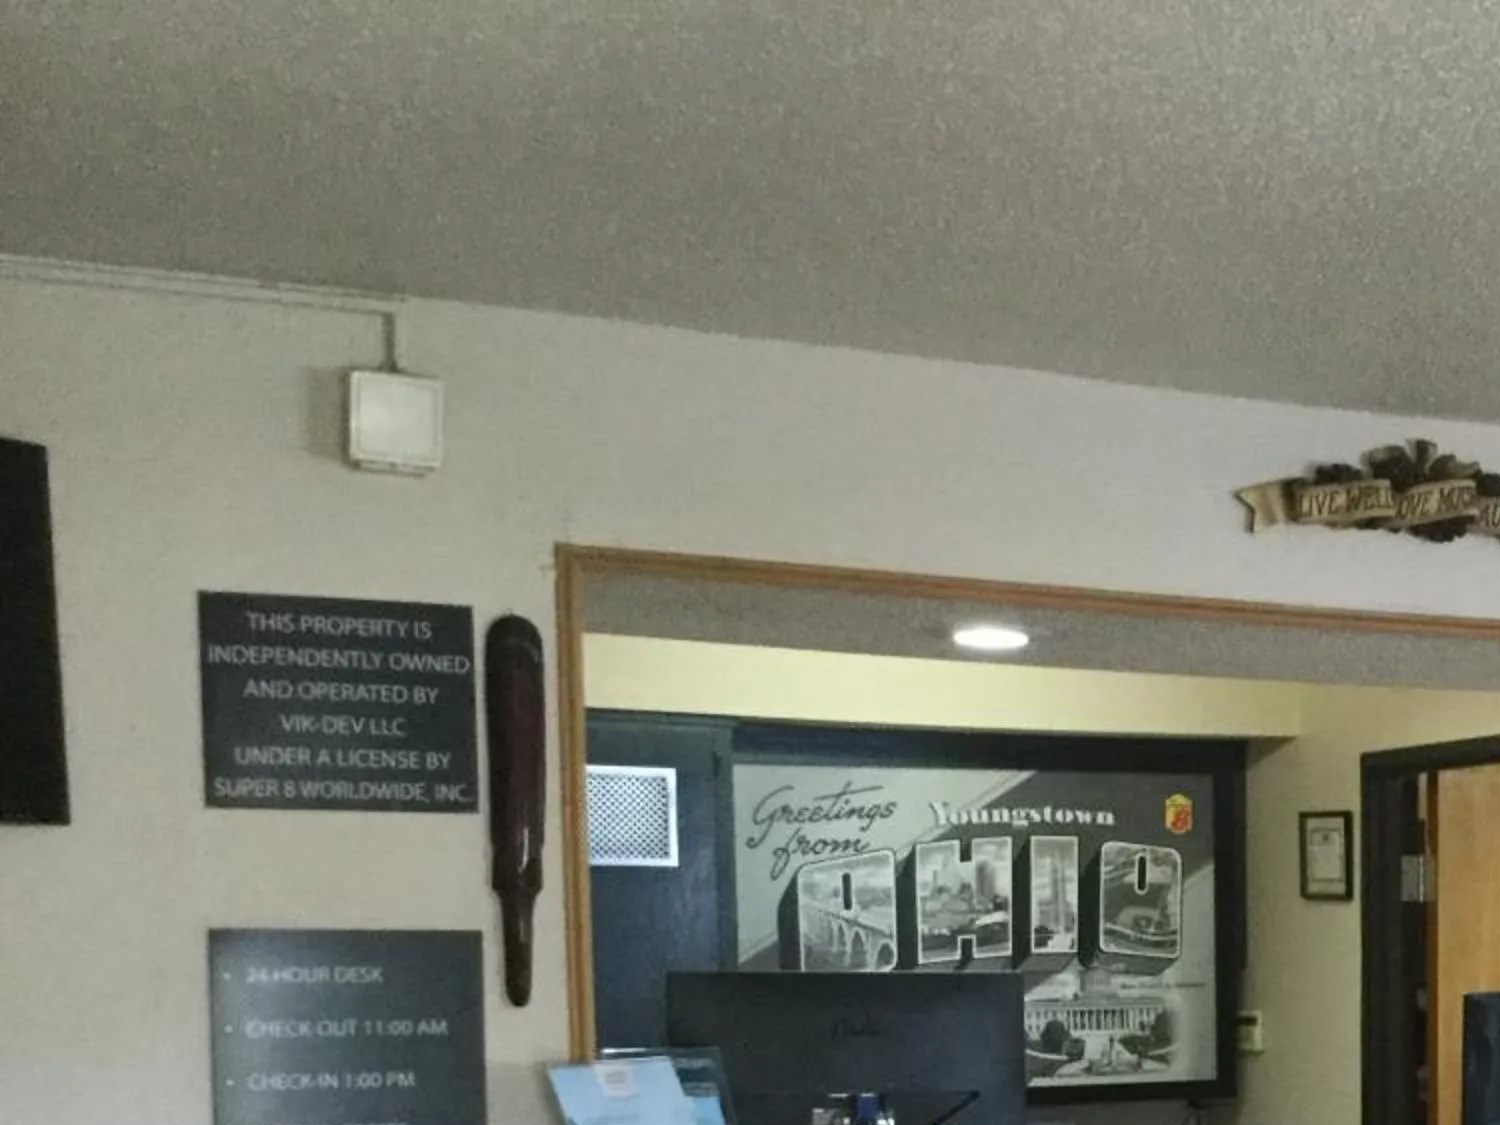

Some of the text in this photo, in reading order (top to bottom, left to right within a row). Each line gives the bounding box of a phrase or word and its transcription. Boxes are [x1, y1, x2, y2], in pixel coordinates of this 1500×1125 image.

[1396, 490, 1430, 521] OVE
[246, 612, 432, 640] THIS PROPERTY IS
[208, 645, 471, 674] INDEPENDENTLY OWNED
[243, 679, 438, 705] AND OPERATED BY
[280, 714, 407, 737] VIK-DEV LLC
[234, 746, 451, 770] UNDER A LICENSE BY
[214, 778, 279, 799] SUPER
[283, 779, 297, 798] 8
[746, 781, 898, 849] Greetings
[929, 800, 1115, 827] Youngstown
[770, 827, 871, 881] from
[797, 835, 1183, 973] OHIO
[247, 965, 384, 984] 24 HOUR DESK
[247, 1018, 449, 1038] CHECK OUT 11:00 AM
[345, 1072, 383, 1089] 1:00
[386, 1071, 416, 1087] PM
